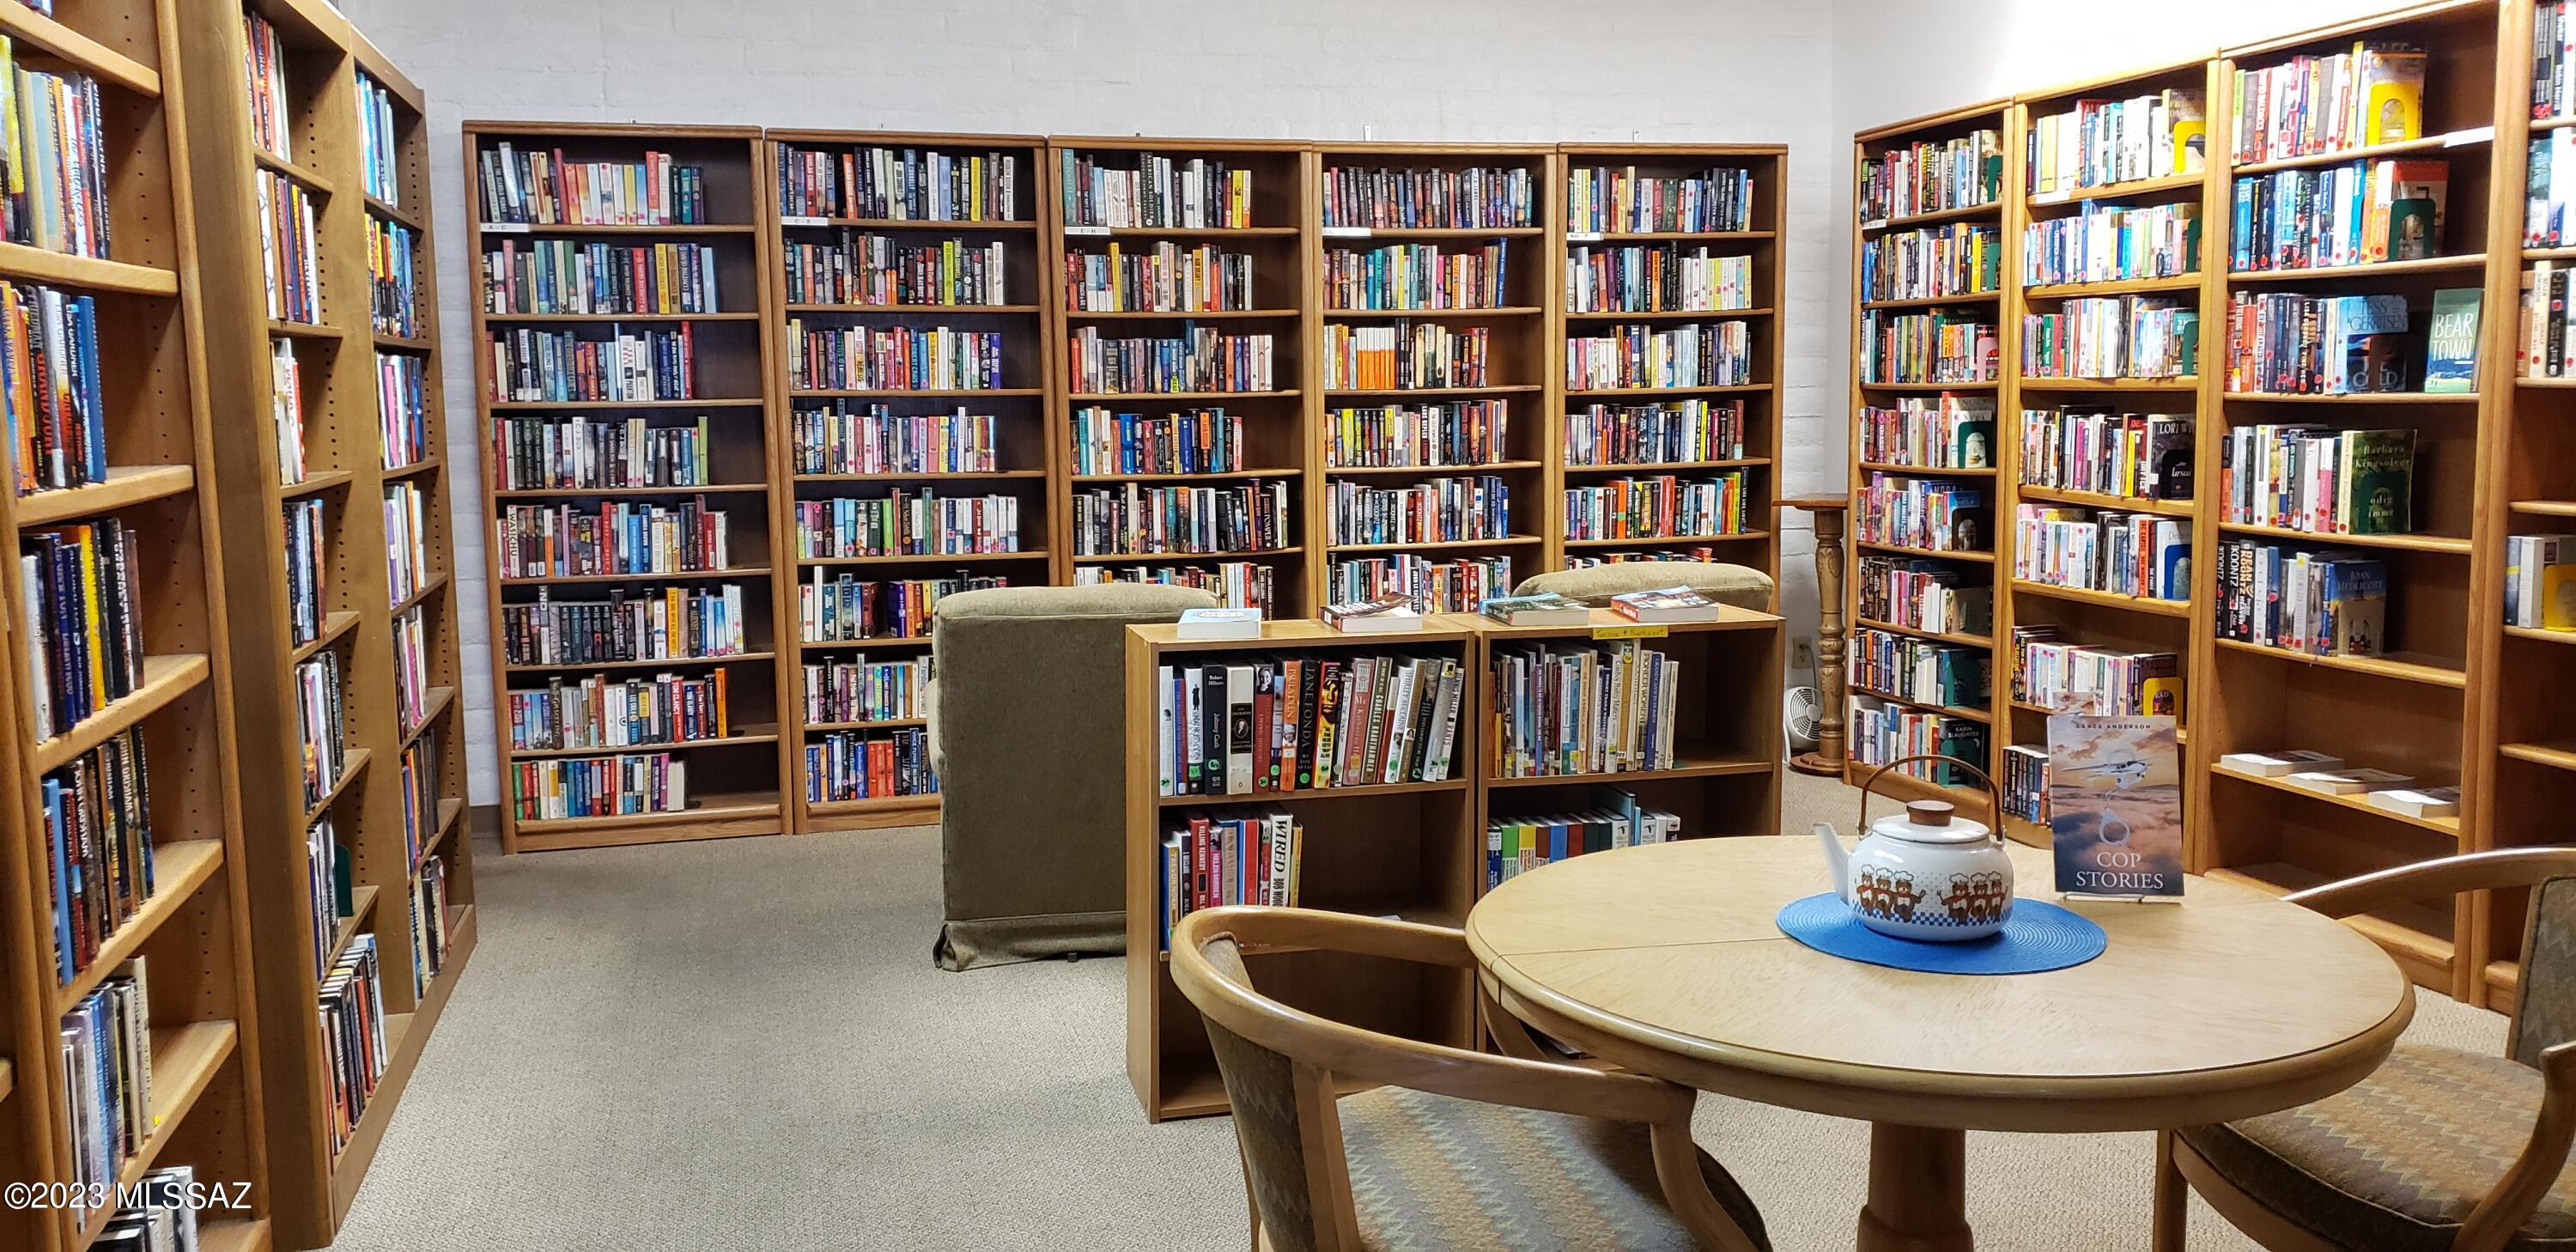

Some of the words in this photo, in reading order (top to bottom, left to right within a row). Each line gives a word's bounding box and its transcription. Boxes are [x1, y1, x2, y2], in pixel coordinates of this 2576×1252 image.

[2555, 15, 2564, 40] Shelter
[92, 83, 101, 127] VINCE
[2553, 86, 2561, 111] Merrill
[96, 130, 106, 173] FLYNN
[102, 193, 111, 241] ASSASSIN
[65, 303, 74, 326] LISA
[2360, 302, 2387, 314] TESS
[27, 295, 42, 349] FRIEDMAN
[2349, 315, 2406, 331] GERRITSEN
[2434, 313, 2474, 337] BEAR
[58, 328, 68, 377] GARDNER
[68, 329, 78, 377] GARDNER
[2432, 338, 2474, 361] TOWN
[35, 352, 49, 412] GRAND
[857, 360, 866, 382] NEMESIS
[625, 379, 635, 399] PHANTOM
[41, 414, 53, 455] JURY
[2160, 423, 2178, 435] LORI
[2363, 444, 2404, 455] Barbara
[2354, 458, 2410, 468] Kingsolver
[672, 682, 681, 694] TOM
[1287, 669, 1296, 696] PAULA
[1304, 667, 1316, 699] JANE
[1402, 672, 1413, 698] SHIRLEY
[1452, 673, 1462, 692] DENNIS
[673, 695, 682, 715] CLANCY
[1286, 696, 1295, 718] DEEN
[1354, 695, 1367, 704] Me
[1373, 695, 1383, 723] CHARLES
[1449, 694, 1458, 714] MILLER
[1613, 701, 1621, 720] Matters
[1212, 713, 1221, 733] Johnny
[1301, 702, 1313, 748] FONDA
[1353, 708, 1363, 745] Katharine
[1443, 725, 1453, 745] RANTS
[119, 738, 130, 766] JOHN
[1366, 726, 1380, 773] KRAUTHAMMER
[74, 769, 84, 800] JOHN
[104, 752, 113, 800] GRISHAM
[121, 767, 133, 811] GRISHAM
[65, 816, 76, 863] BROKER
[76, 802, 88, 859] GRISHAM
[109, 811, 119, 879] RECKONING
[1274, 819, 1288, 872] WIRED
[2097, 852, 2141, 867] COP
[1273, 878, 1285, 890] BOB
[2076, 871, 2164, 889] STORIES
[1273, 891, 1284, 907] WOOD
